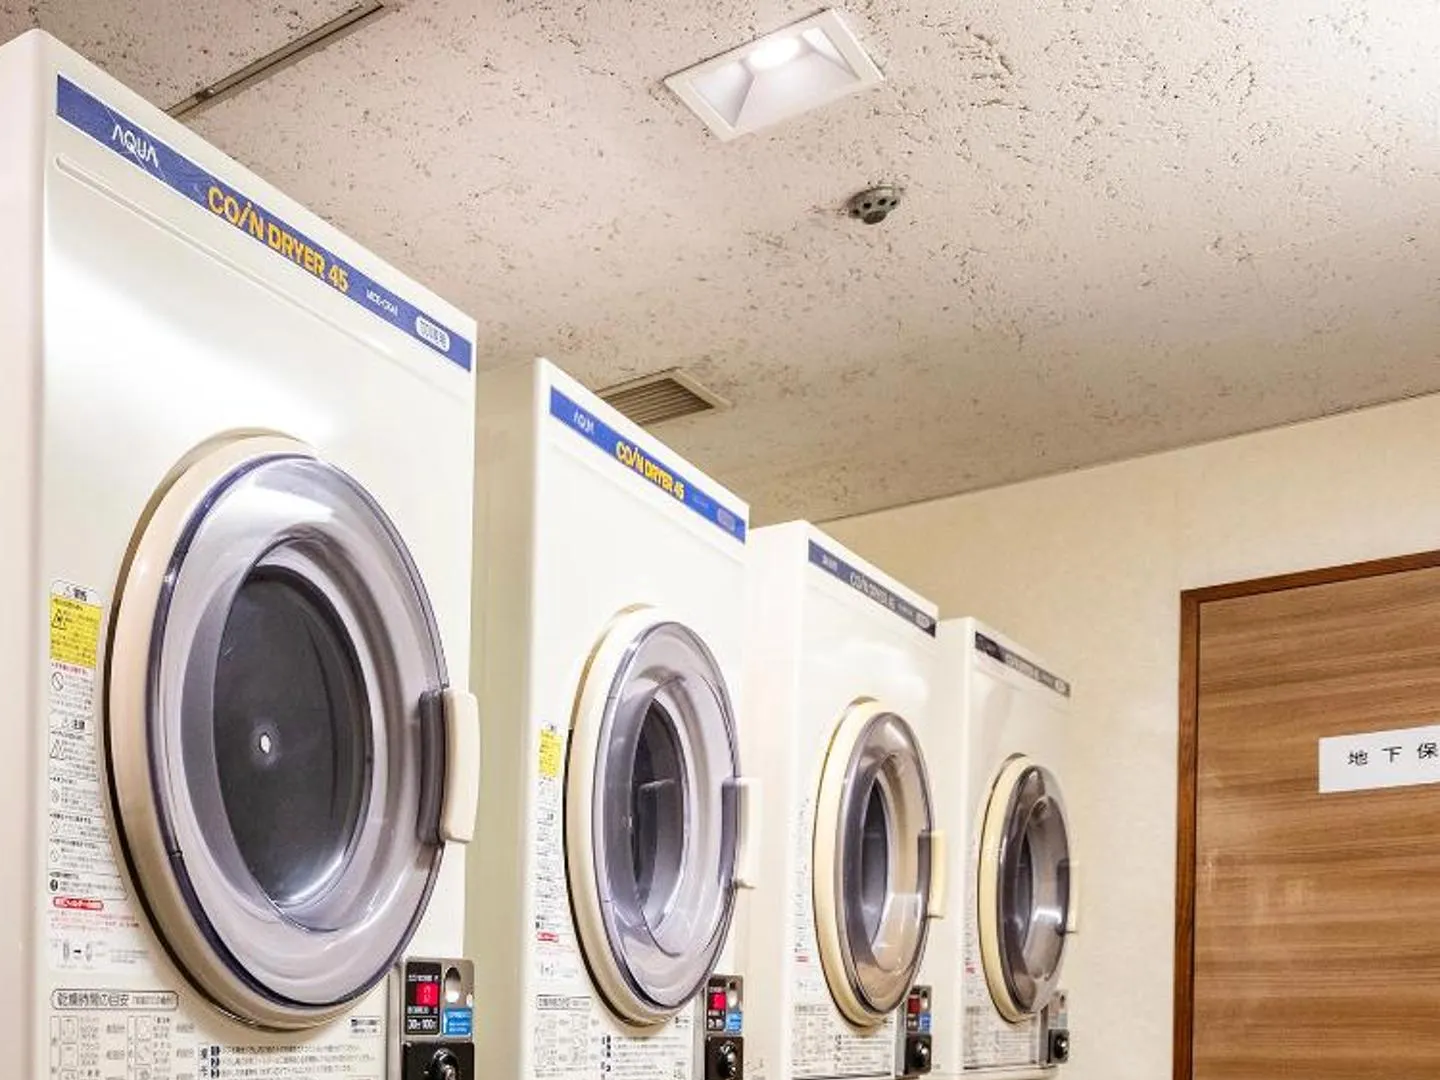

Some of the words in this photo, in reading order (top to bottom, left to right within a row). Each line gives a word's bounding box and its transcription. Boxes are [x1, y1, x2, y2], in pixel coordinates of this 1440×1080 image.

[111, 124, 159, 168] AQUA
[208, 186, 264, 241] COIN
[268, 224, 325, 277] DRYER
[328, 262, 348, 292] 45
